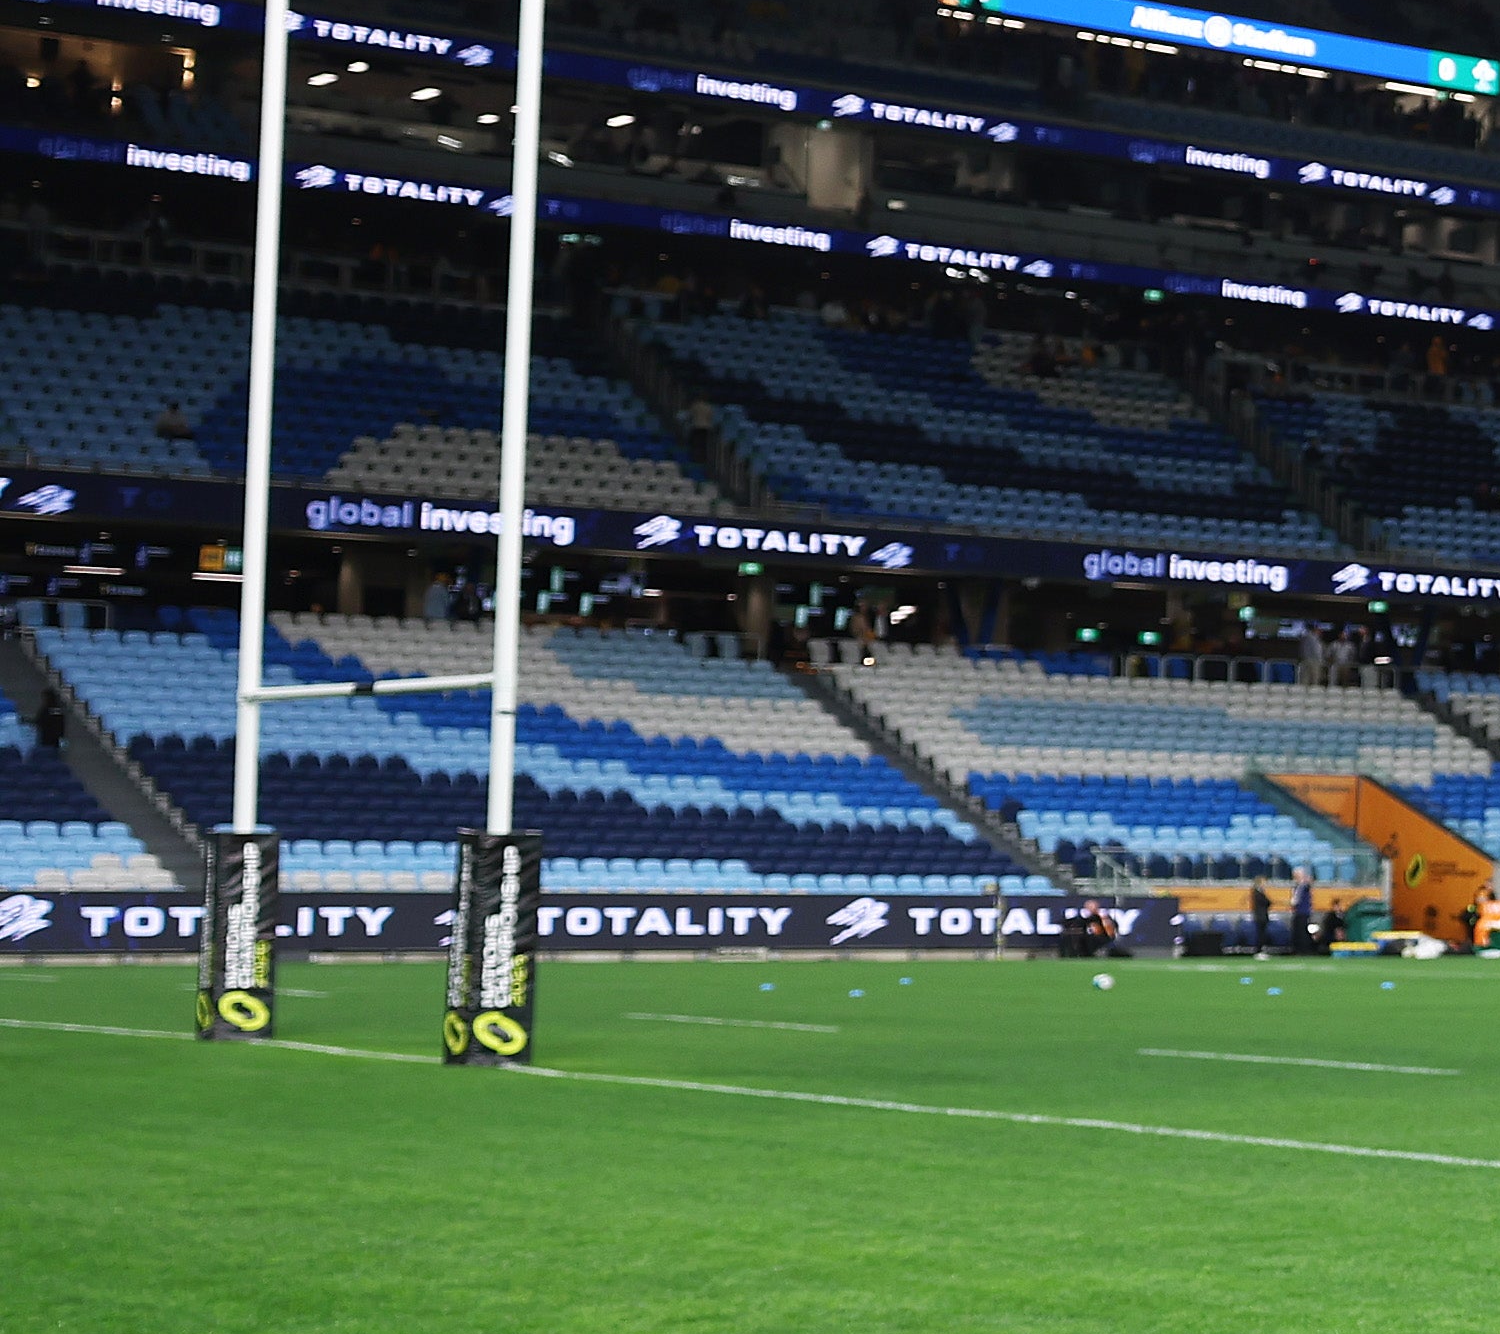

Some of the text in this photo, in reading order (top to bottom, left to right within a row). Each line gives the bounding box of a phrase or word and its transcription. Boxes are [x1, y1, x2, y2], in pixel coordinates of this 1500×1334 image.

[312, 19, 452, 55] TOTALITY
[696, 73, 797, 111] investing
[870, 101, 985, 133] TOTALITY
[126, 144, 251, 183] investing
[1185, 145, 1270, 180] investing
[344, 173, 484, 207] TOTALITY
[1330, 169, 1428, 197] TOTALITY
[730, 218, 831, 253] investing
[904, 242, 1020, 271] TOTALITY
[1221, 278, 1308, 309] investing
[1367, 298, 1466, 325] TOTALITY
[305, 495, 575, 546] global invesing
[694, 525, 867, 557] TOTALITY
[1083, 550, 1289, 593] global investing
[80, 906, 393, 937] TOTITY
[536, 906, 792, 936] TOTALITY
[908, 907, 1140, 935] TOTALY
